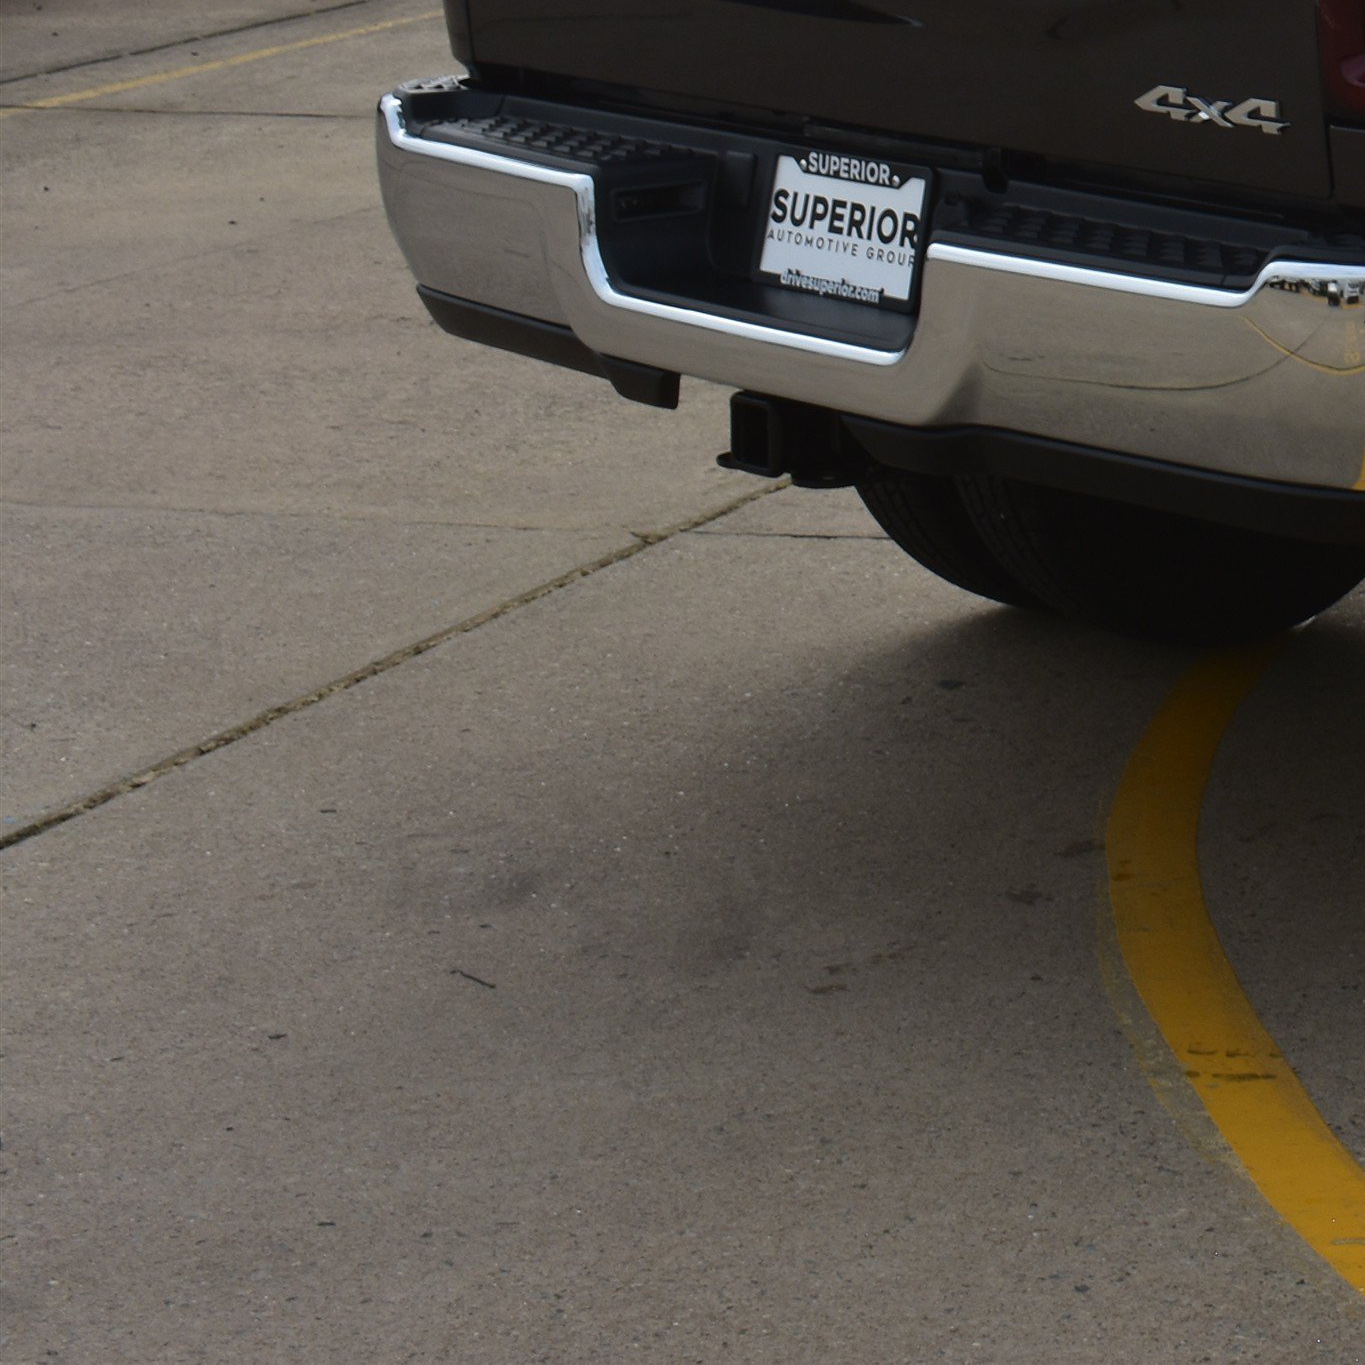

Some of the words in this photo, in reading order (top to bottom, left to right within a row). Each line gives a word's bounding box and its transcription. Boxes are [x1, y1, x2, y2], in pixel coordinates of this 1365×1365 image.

[1134, 85, 1291, 135] 4x4
[808, 151, 891, 185] SUPERIOR
[770, 188, 921, 250] SUPERIOR
[767, 227, 859, 257] AUTOMOTIVE
[780, 270, 880, 304] drivesuperior.com
